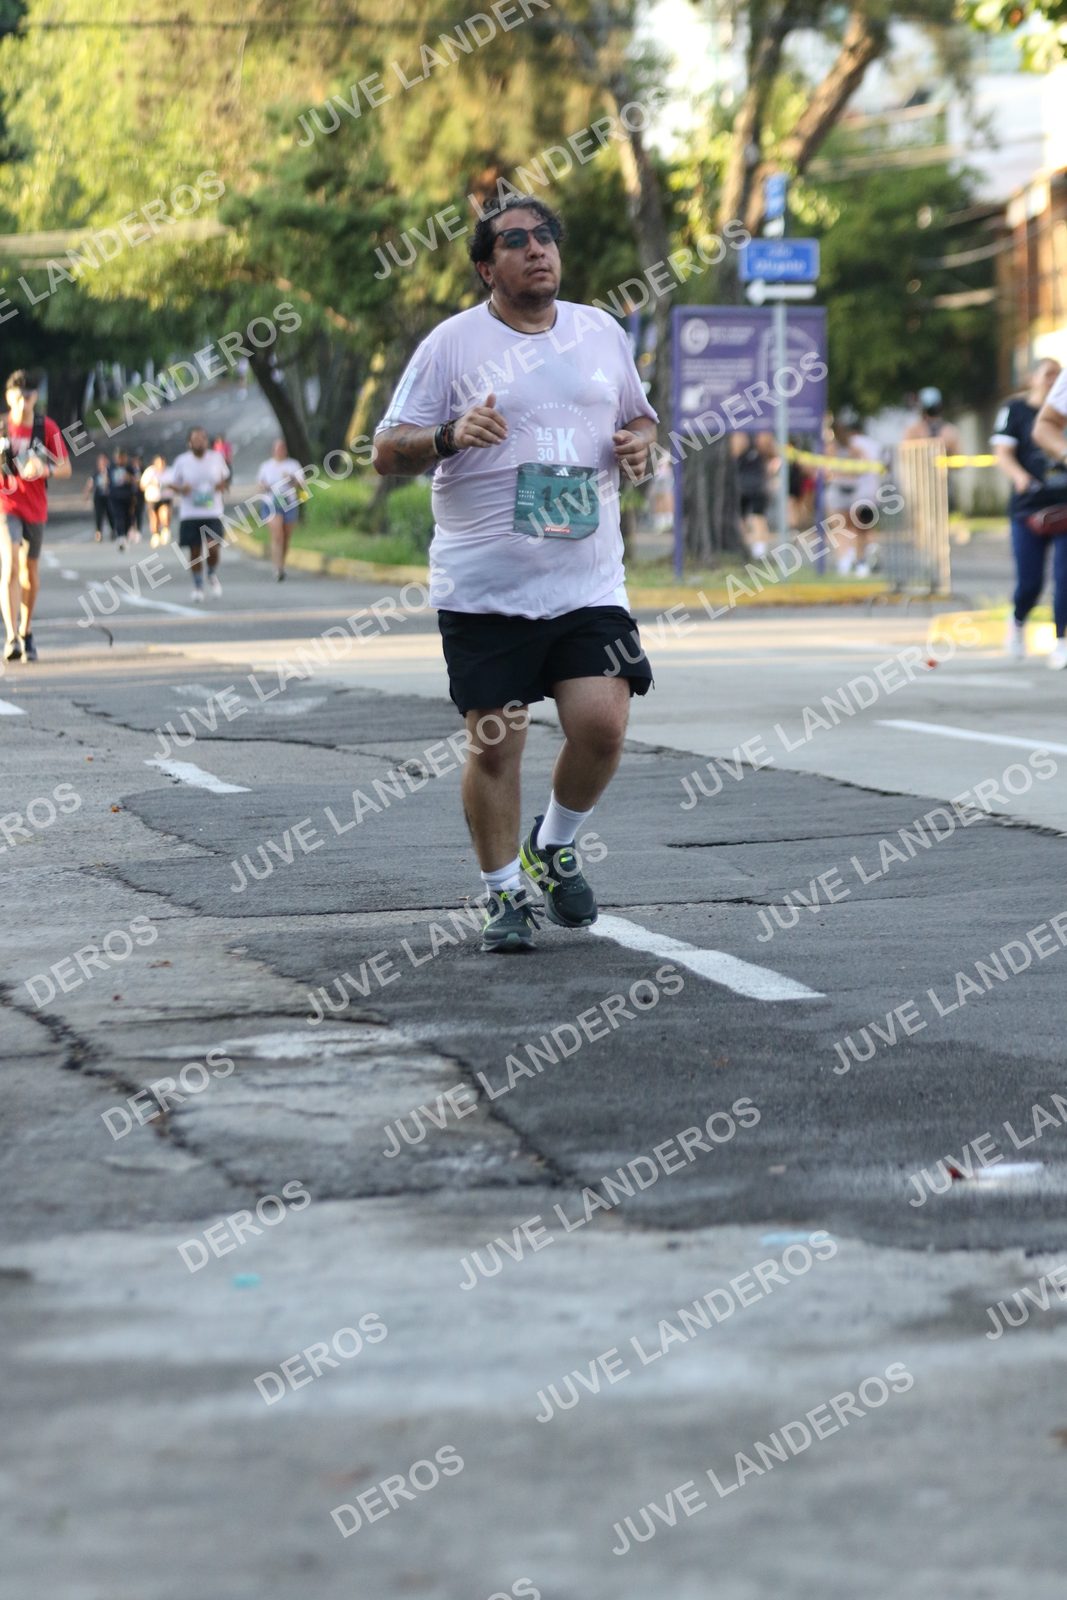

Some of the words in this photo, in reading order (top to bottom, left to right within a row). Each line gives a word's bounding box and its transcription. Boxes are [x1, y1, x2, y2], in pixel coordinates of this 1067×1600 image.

[536, 427, 553, 442] 15
[556, 427, 581, 463] K
[537, 447, 554, 461] 30
